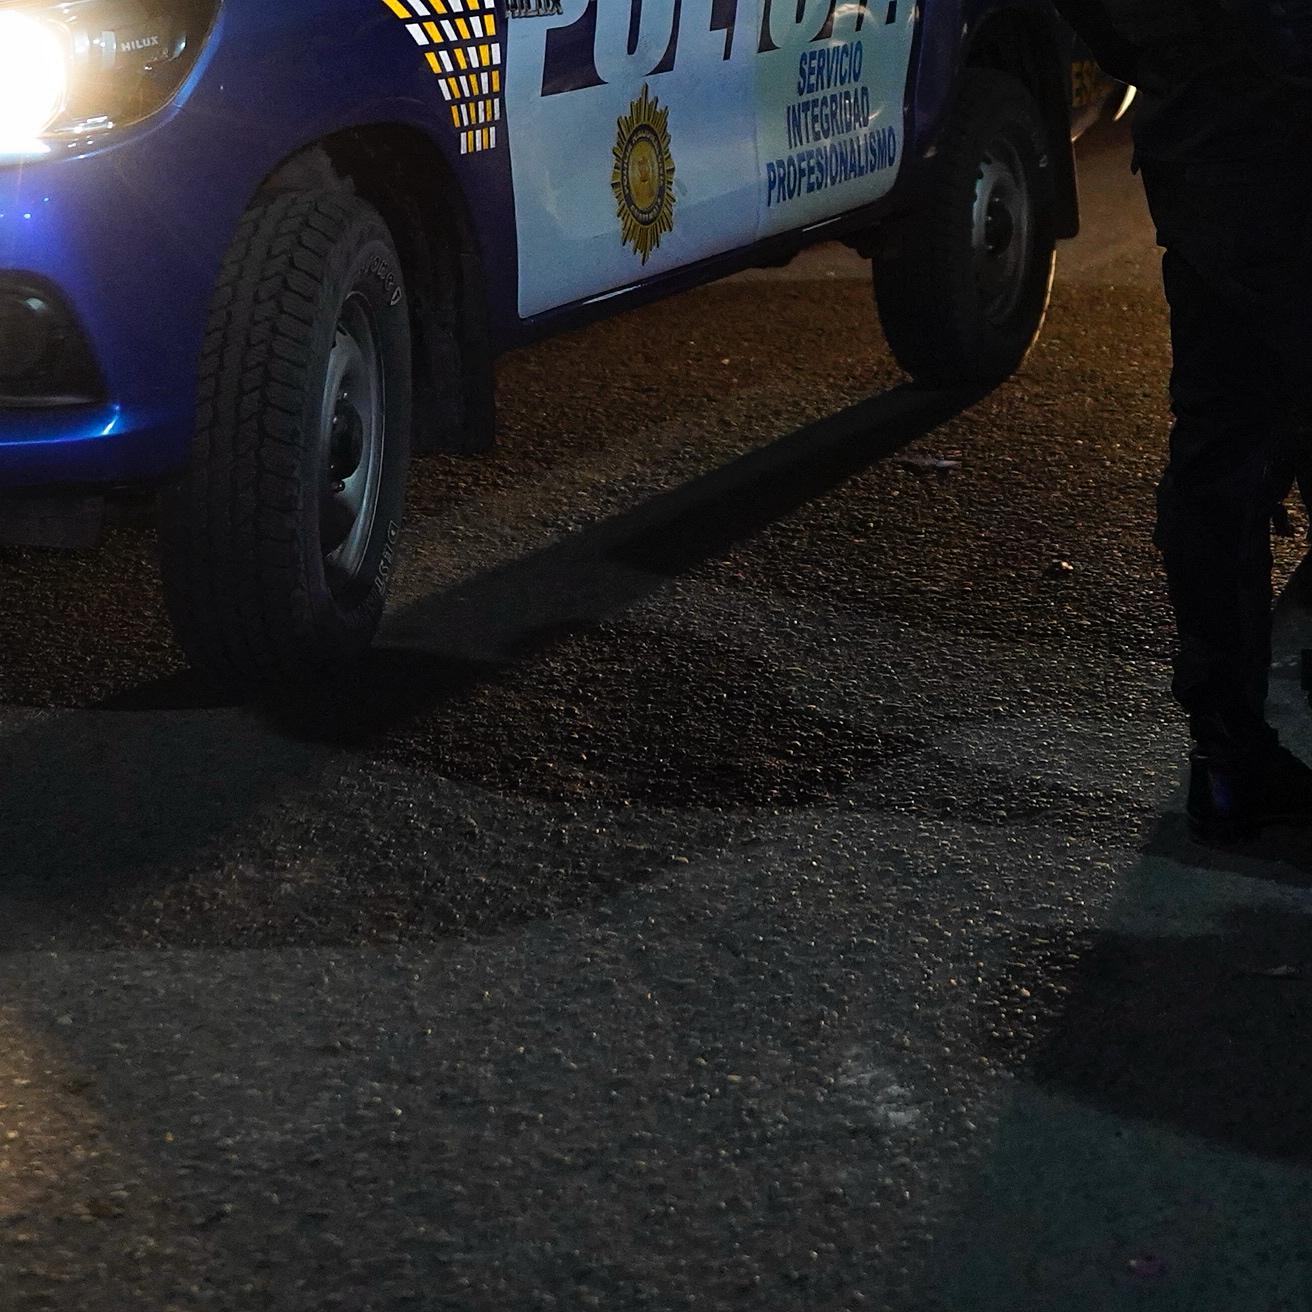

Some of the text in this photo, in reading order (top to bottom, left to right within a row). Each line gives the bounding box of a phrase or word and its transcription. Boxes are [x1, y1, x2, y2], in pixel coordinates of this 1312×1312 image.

[121, 36, 159, 51] HILUX
[798, 40, 864, 96] SERVICIO
[786, 86, 870, 149] INTEGRIDAD
[766, 125, 896, 207] PROFESIONALISMO
